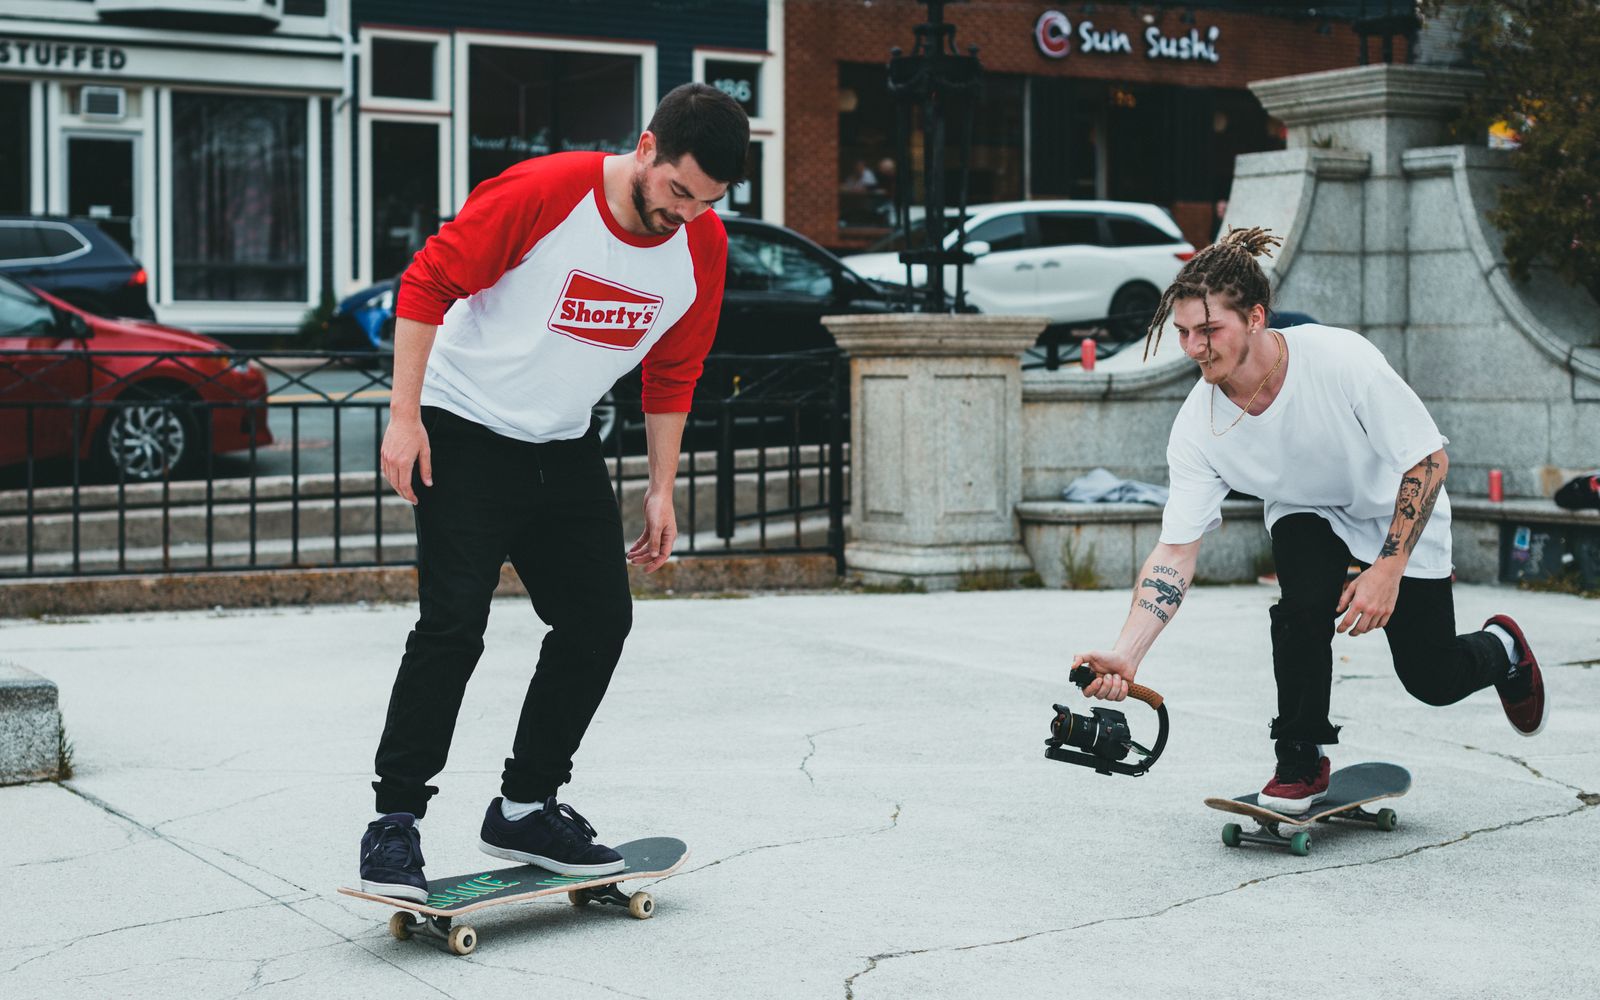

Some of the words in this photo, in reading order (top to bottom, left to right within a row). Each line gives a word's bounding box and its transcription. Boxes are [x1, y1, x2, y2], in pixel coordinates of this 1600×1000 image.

[0, 40, 127, 70] STUFFED
[1078, 20, 1132, 53] Sun
[1145, 25, 1220, 62] Sushi
[560, 299, 654, 329] Shorty's
[1152, 565, 1179, 578] SHOOT
[1137, 598, 1169, 624] SKATERS
